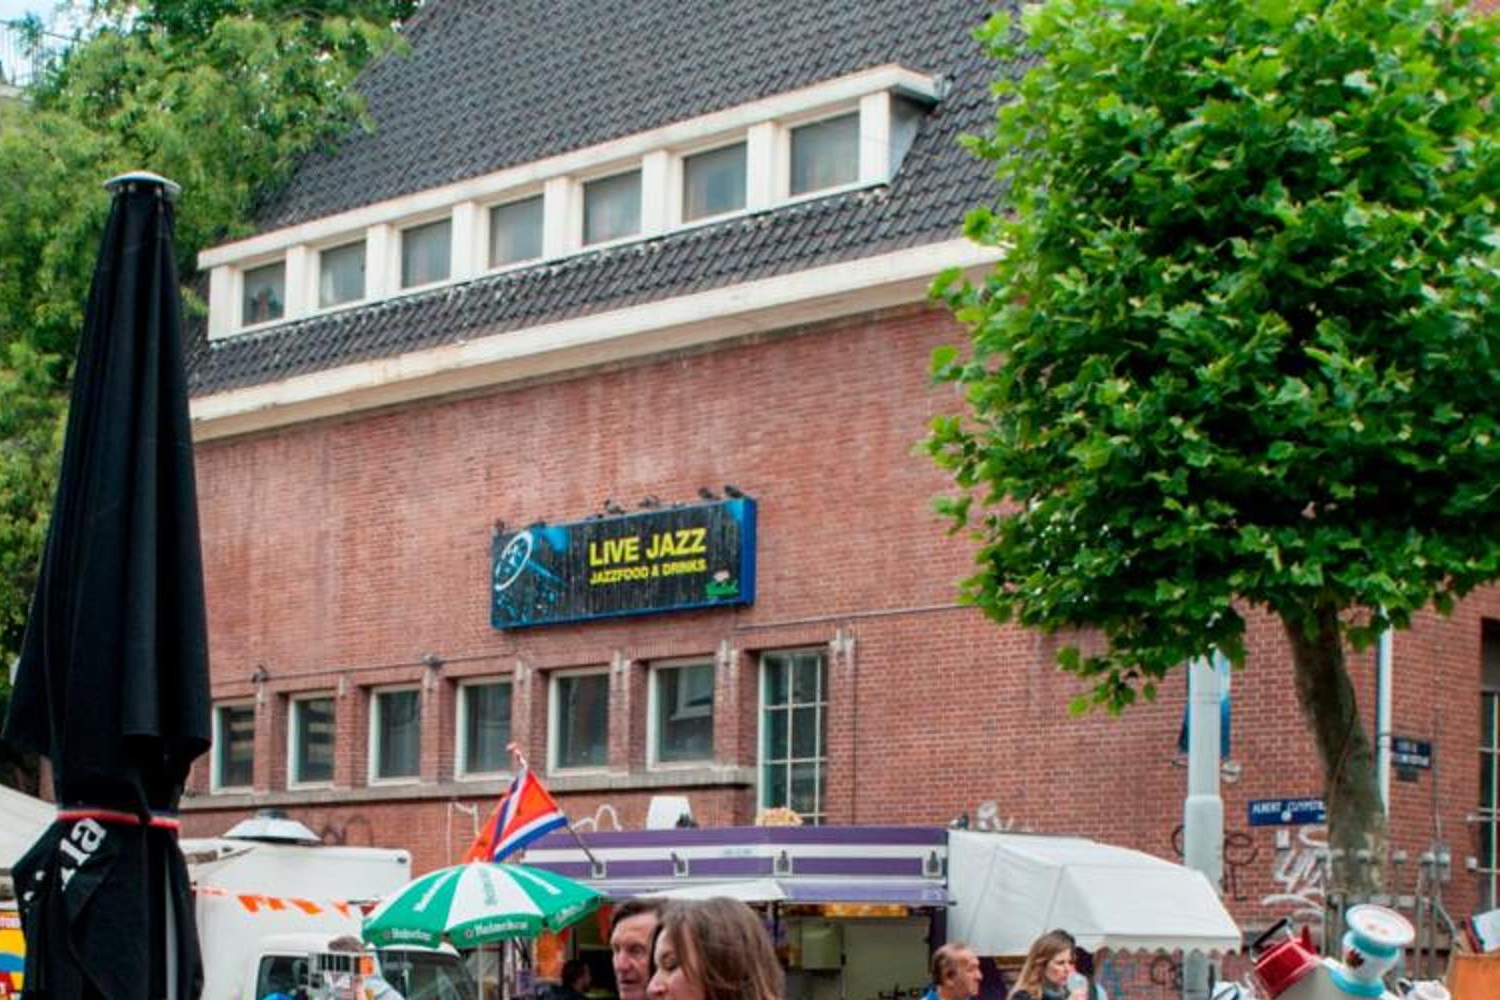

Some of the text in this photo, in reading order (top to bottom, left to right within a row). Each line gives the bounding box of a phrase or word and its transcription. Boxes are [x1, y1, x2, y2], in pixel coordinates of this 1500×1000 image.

[589, 528, 707, 567] LIVE JAZZ
[590, 565, 648, 585] JAZZFOOD
[662, 558, 707, 576] DRINKS
